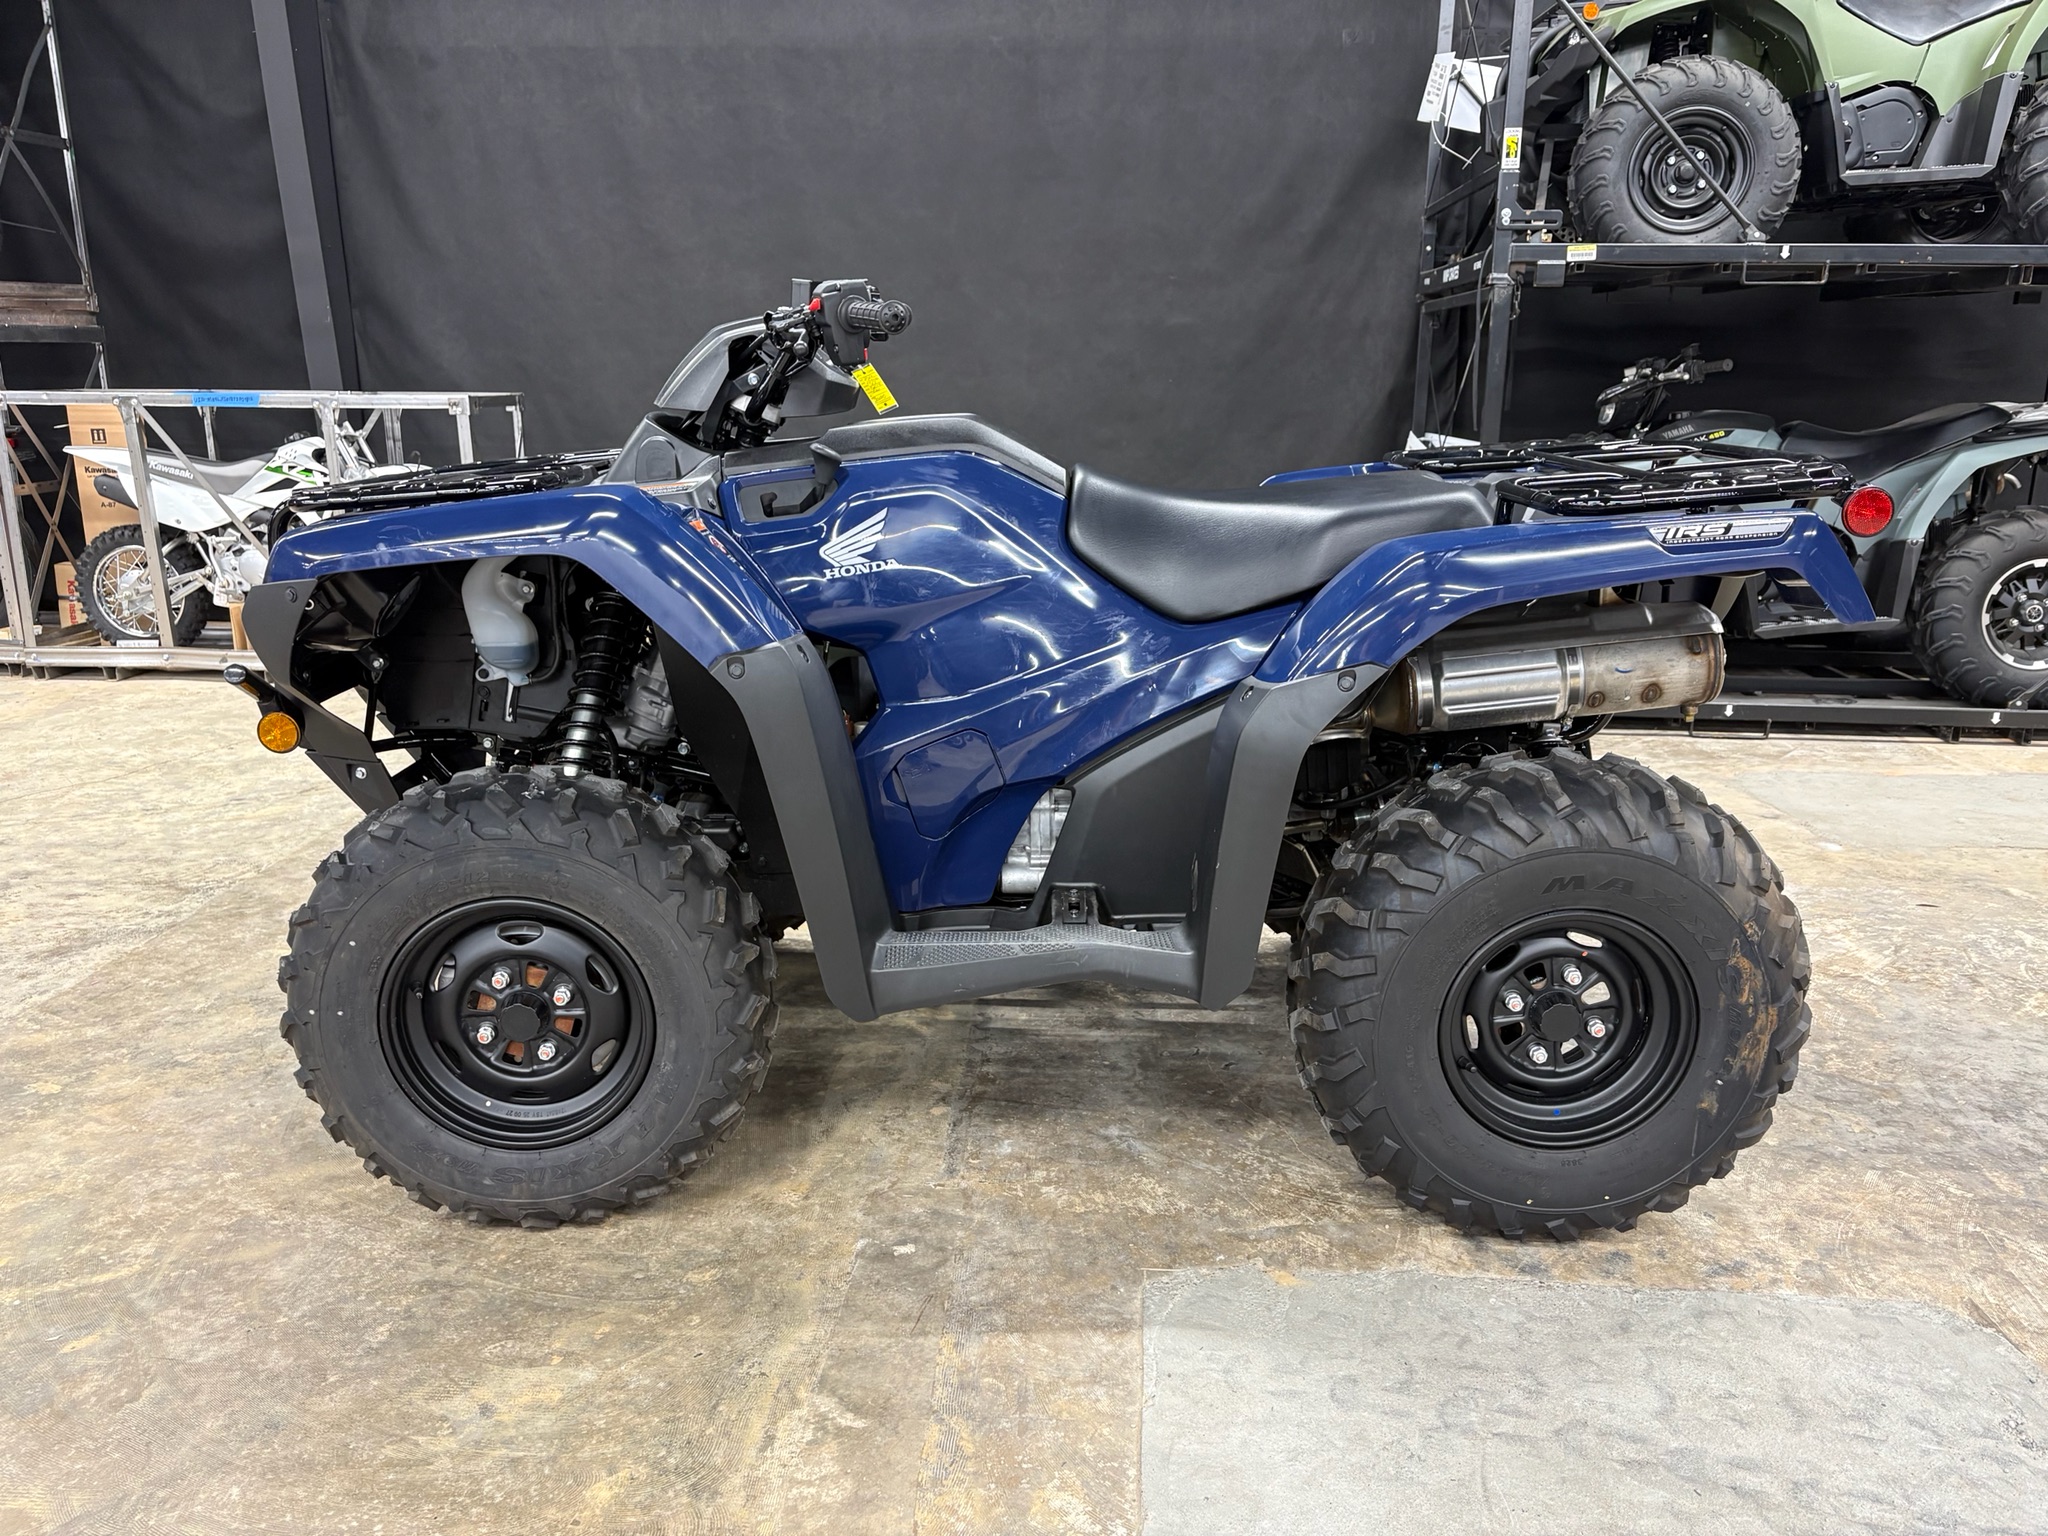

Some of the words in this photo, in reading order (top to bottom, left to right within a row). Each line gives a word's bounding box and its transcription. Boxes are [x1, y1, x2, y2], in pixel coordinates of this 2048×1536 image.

[1662, 424, 1695, 439] YAMAHA
[1708, 430, 1725, 440] 450
[149, 460, 194, 480] Kawasaki
[1662, 522, 1733, 539] IRS
[823, 558, 901, 580] HONDA
[1540, 875, 1743, 997] MAXXIS
